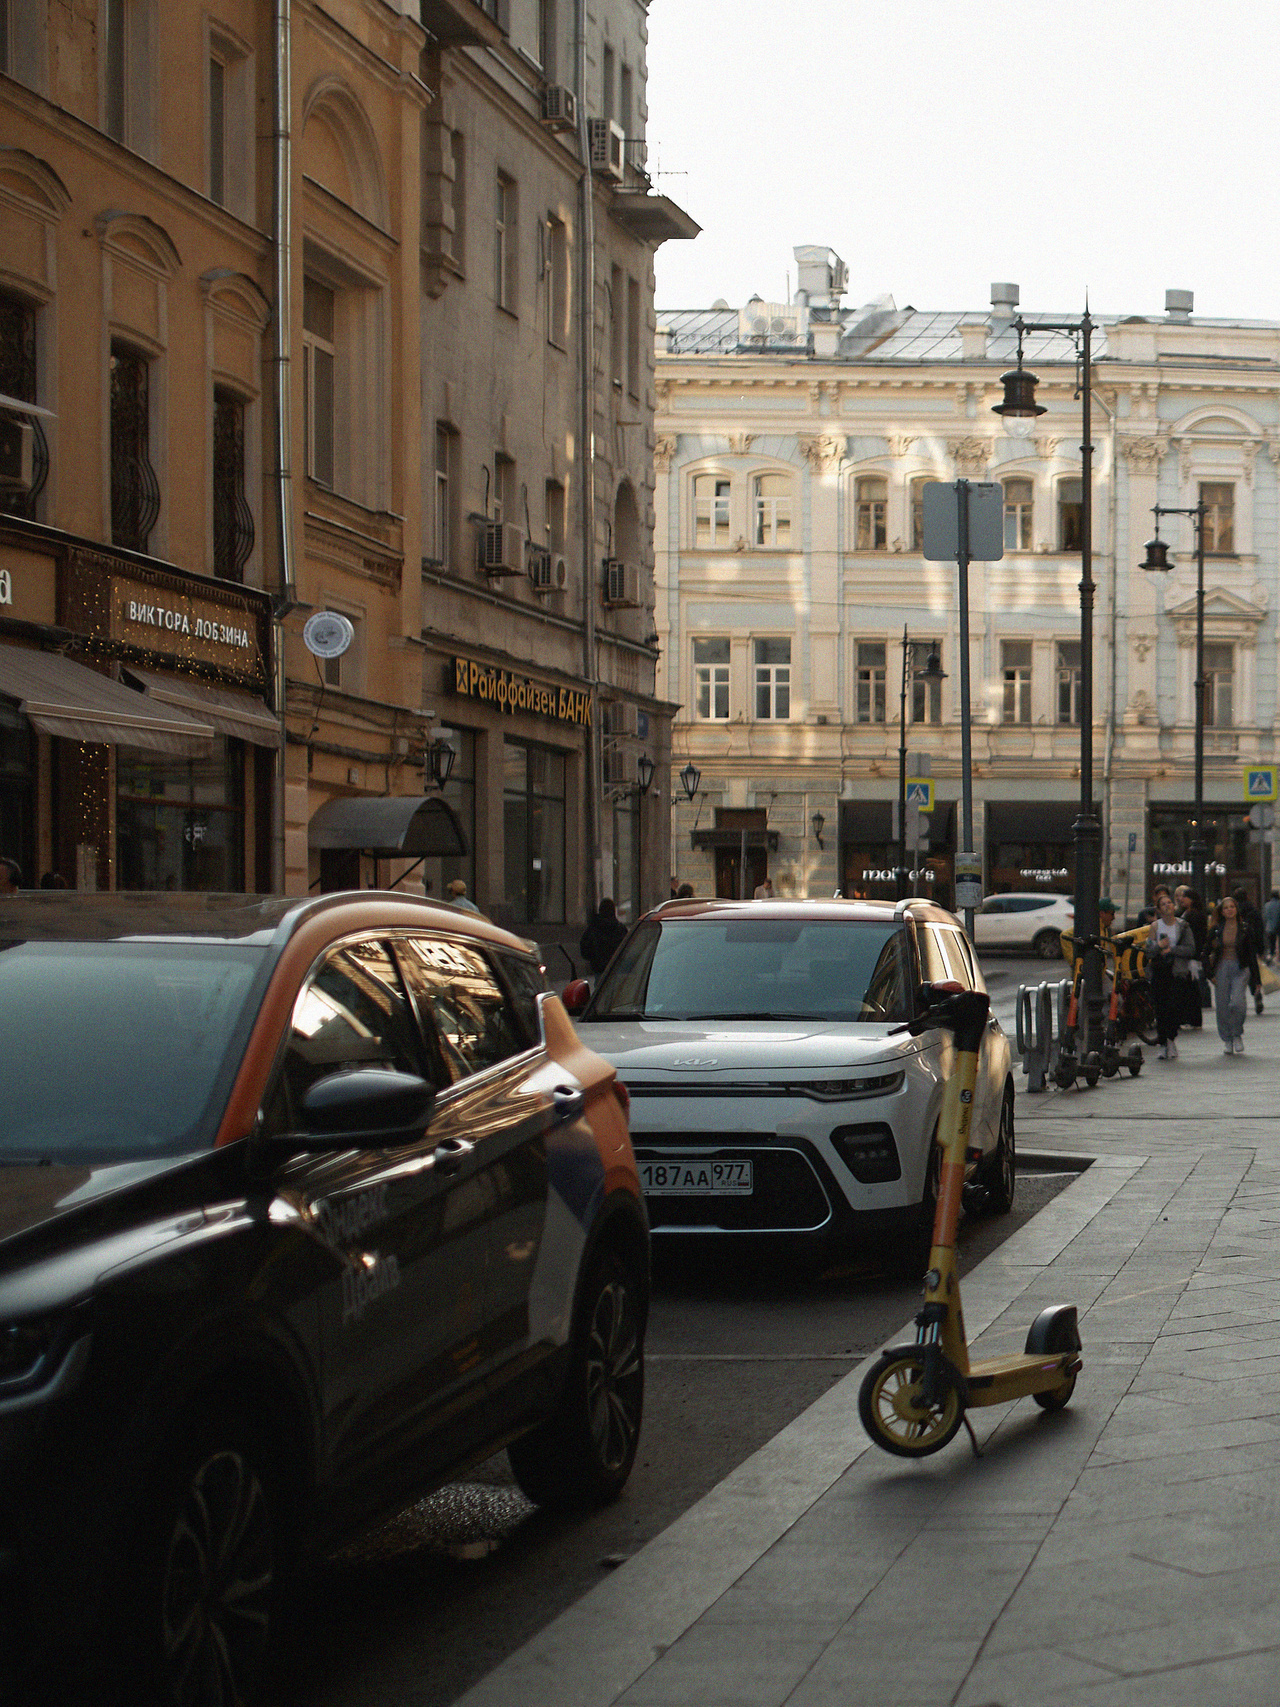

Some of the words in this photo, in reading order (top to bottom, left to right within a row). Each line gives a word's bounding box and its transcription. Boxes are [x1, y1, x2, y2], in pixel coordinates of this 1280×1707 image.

[130, 601, 190, 634] ВИКТОРА
[195, 618, 249, 648] ЛОБЗИНА
[469, 661, 556, 715] Райффайзен
[558, 687, 592, 726] БАНК
[713, 1164, 745, 1180] 977
